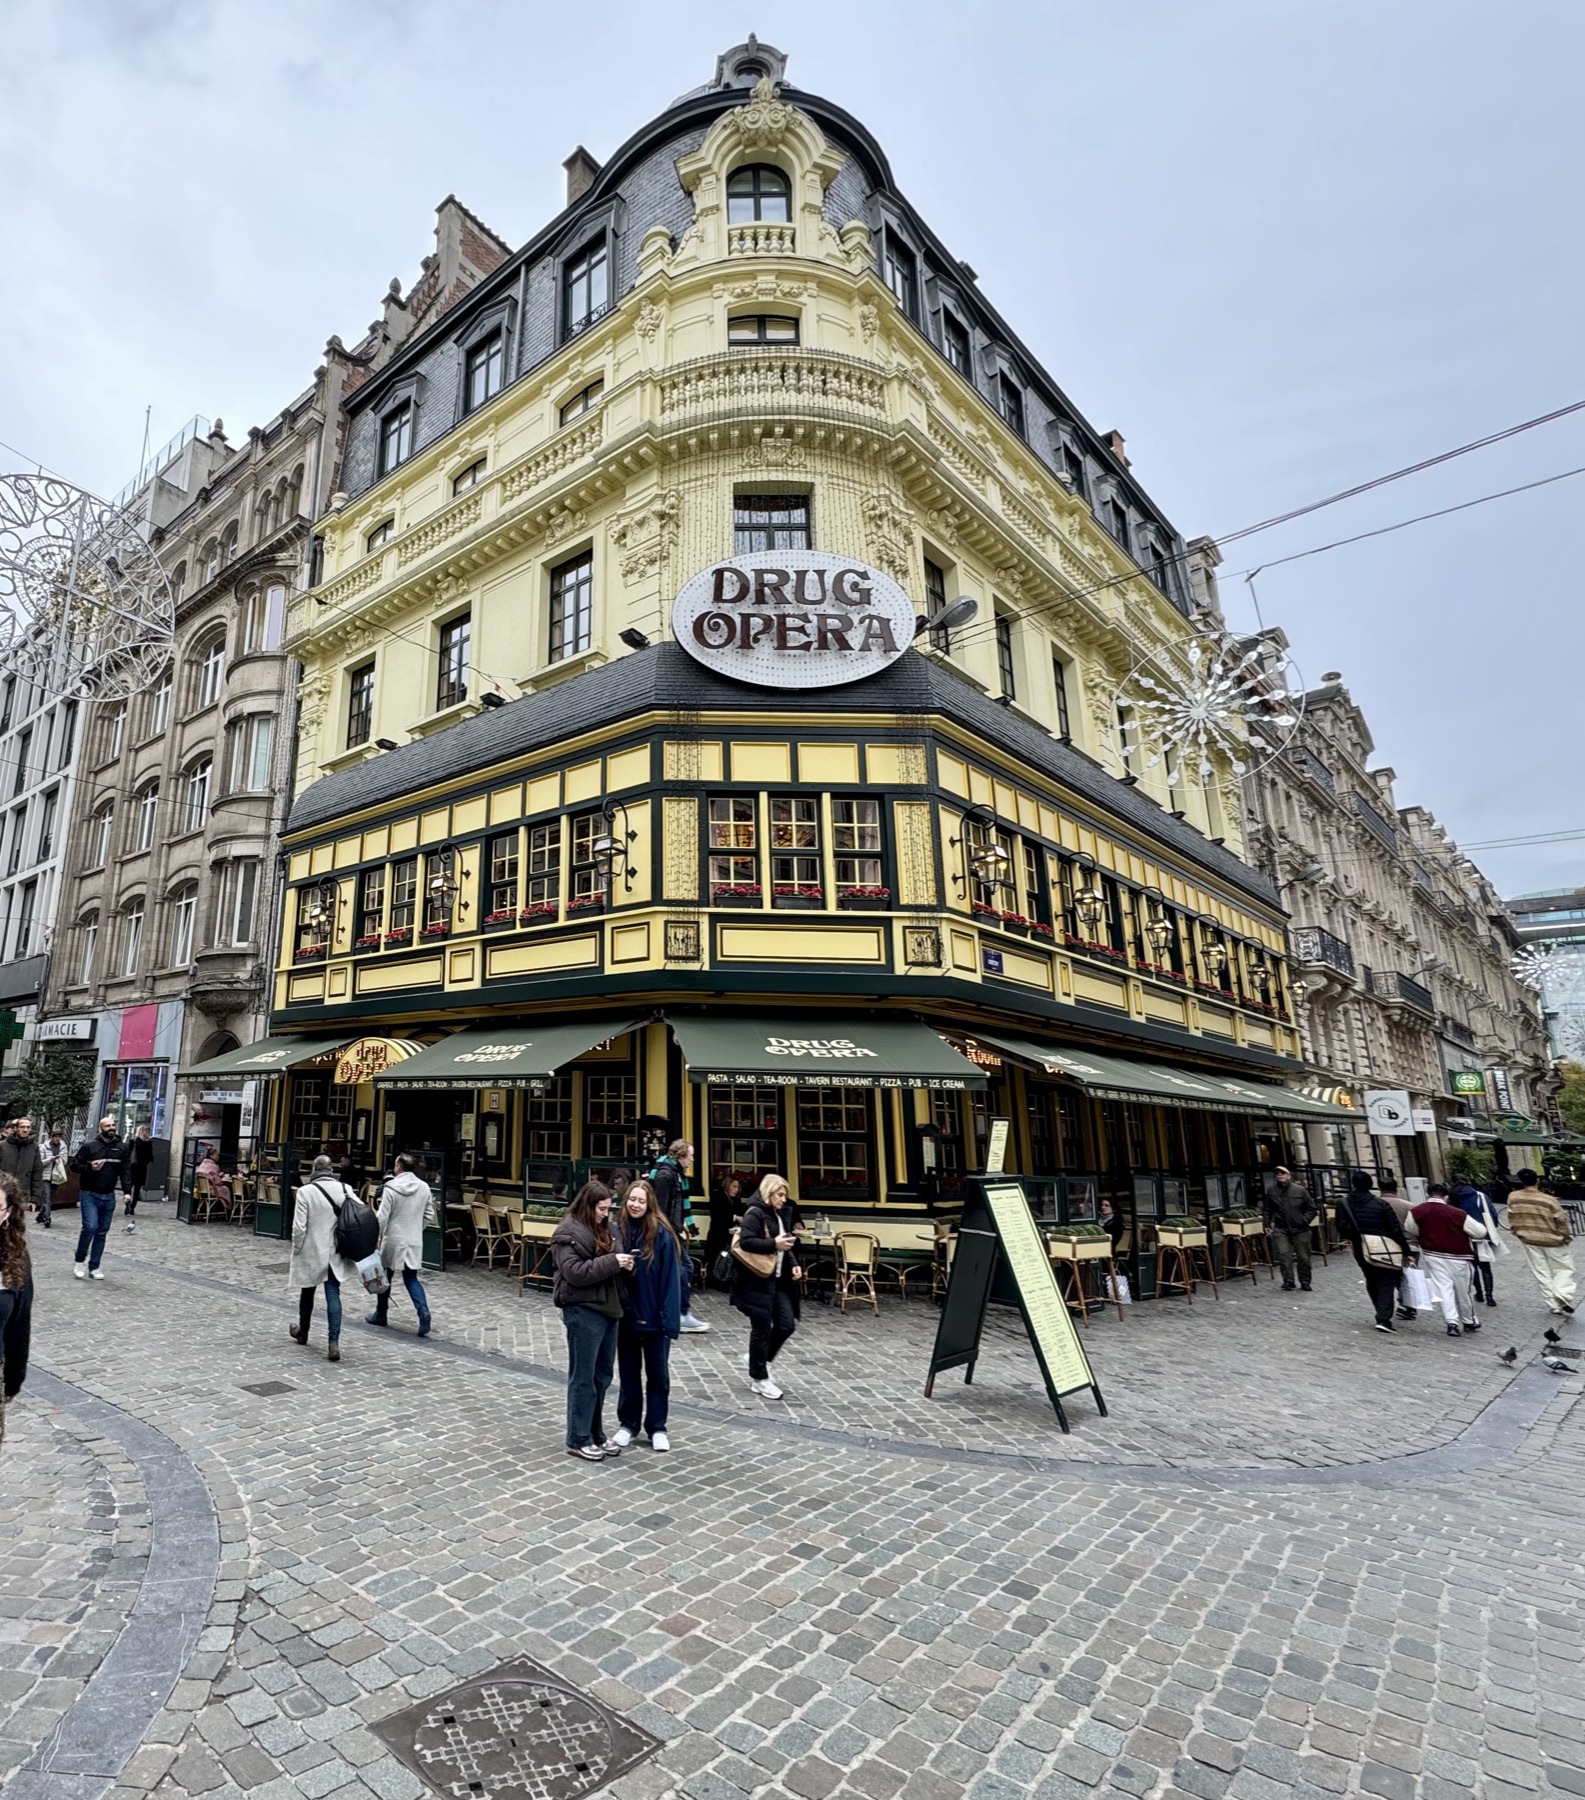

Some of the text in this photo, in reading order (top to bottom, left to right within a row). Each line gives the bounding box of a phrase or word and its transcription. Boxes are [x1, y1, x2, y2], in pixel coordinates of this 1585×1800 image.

[711, 566, 874, 607] DRUG
[692, 610, 901, 653] OPERA
[473, 1043, 533, 1053] DRUG
[767, 1037, 856, 1049] DRUG
[453, 1051, 523, 1063] OPERA
[765, 1045, 878, 1058] OPERA
[708, 1074, 965, 1088] PASTA SALAD TEA-ROOM TAVERN RESTAURANT PIZZA PUB ICE CREAM
